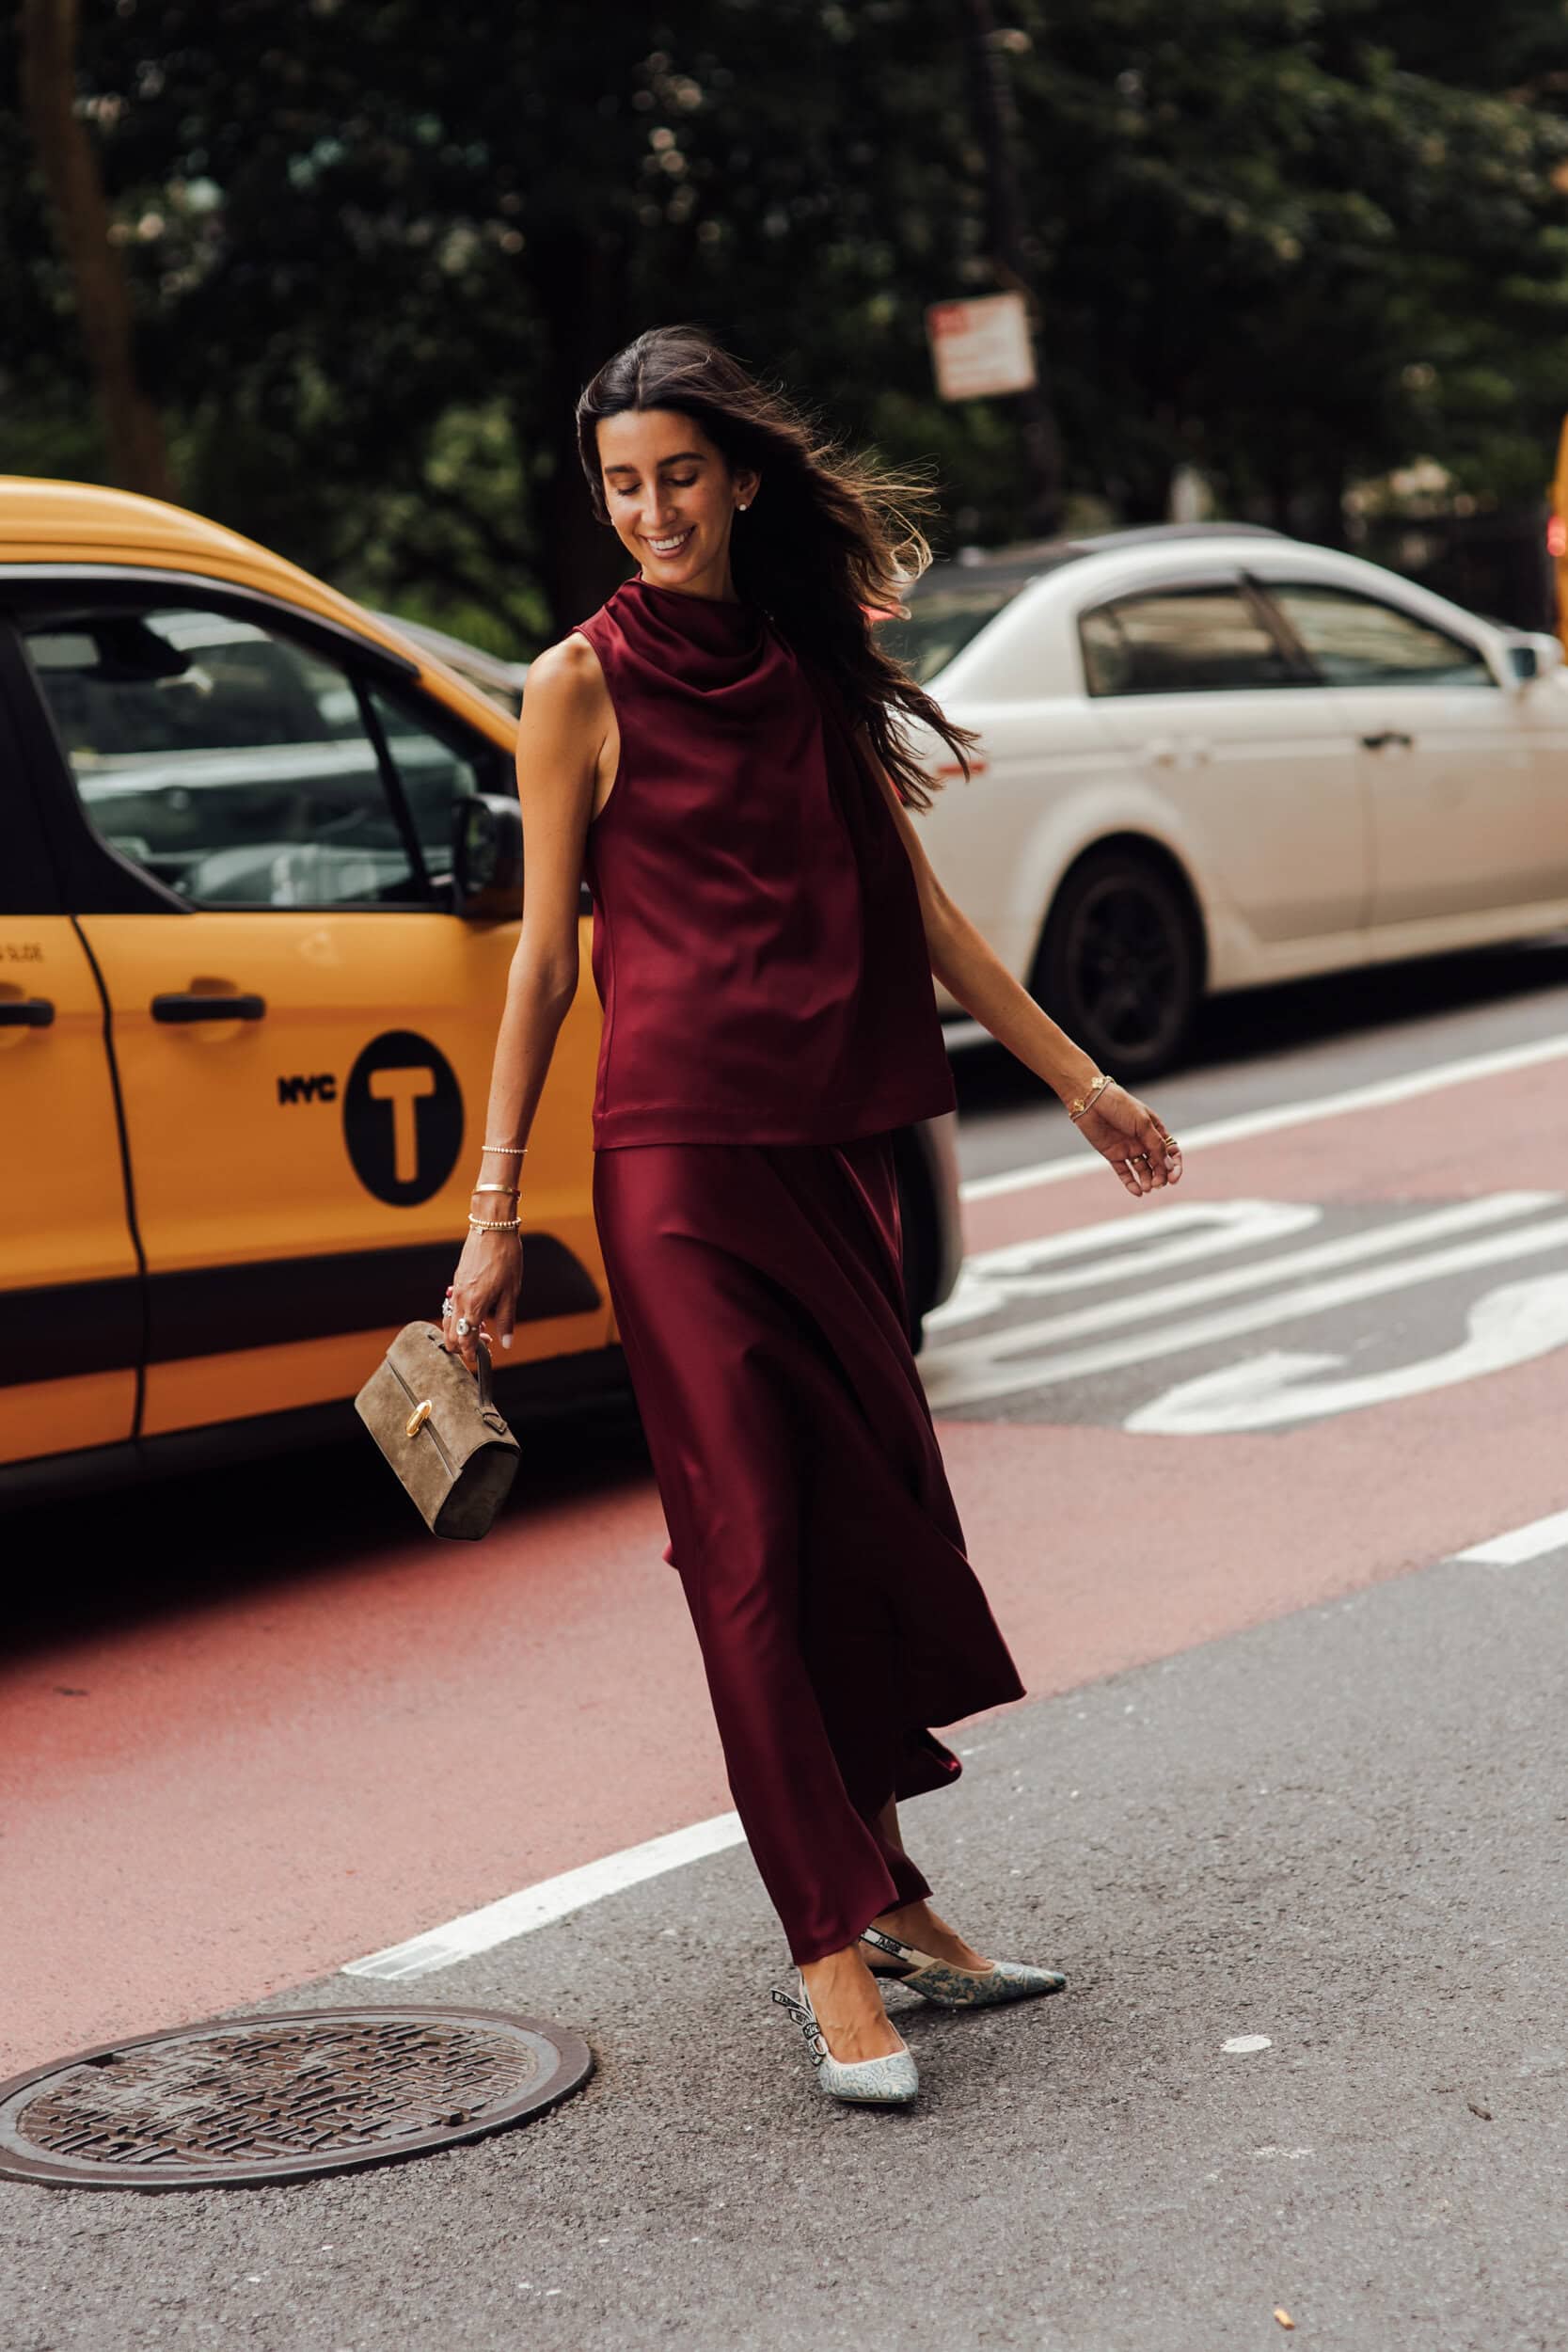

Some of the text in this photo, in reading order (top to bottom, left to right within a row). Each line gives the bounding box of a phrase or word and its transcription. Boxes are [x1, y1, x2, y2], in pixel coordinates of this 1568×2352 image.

[277, 1067, 436, 1183] NYC T
[63, 2088, 184, 2113] MADE
[210, 2110, 334, 2146] INDIA
